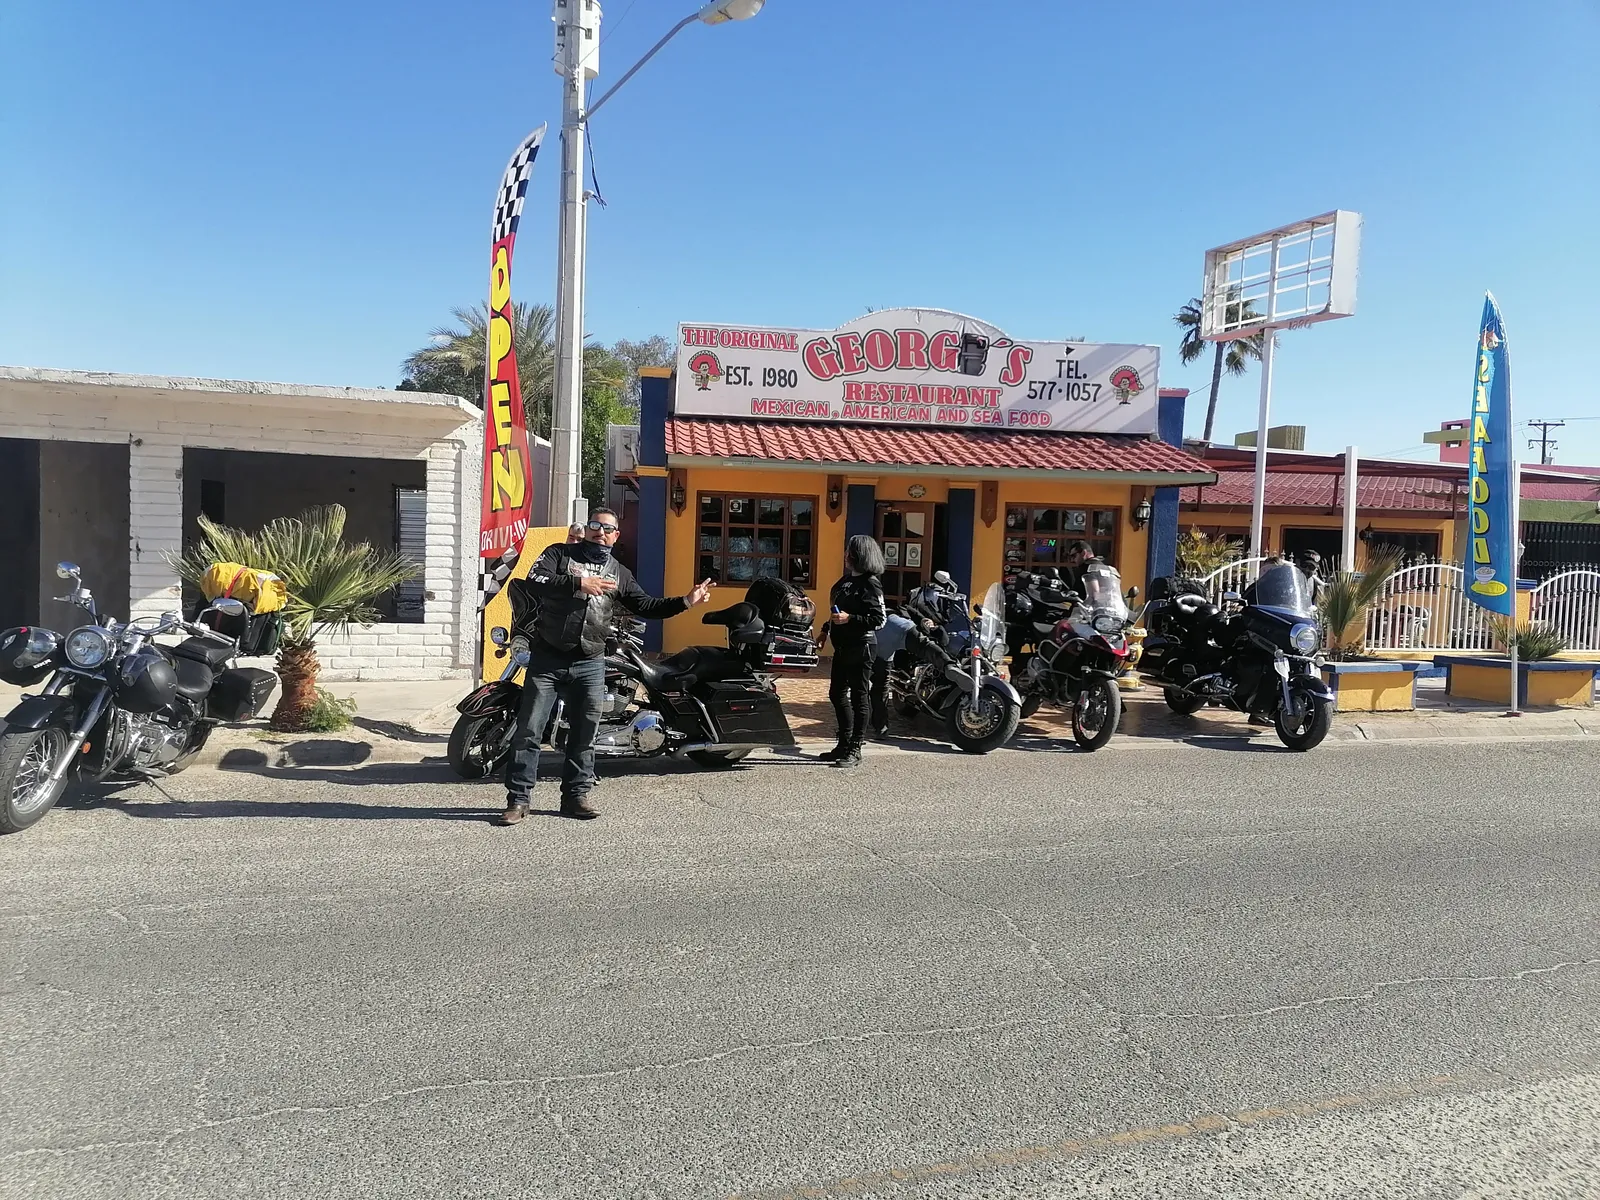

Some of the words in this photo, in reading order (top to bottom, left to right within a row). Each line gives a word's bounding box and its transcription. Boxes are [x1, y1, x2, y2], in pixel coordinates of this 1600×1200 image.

[682, 327, 718, 347] THE
[720, 330, 799, 351] ORIGINAL
[802, 328, 1034, 386] GEORG'S
[490, 246, 526, 511] OPEN
[725, 365, 753, 386] EST.
[762, 367, 798, 388] 1980
[1056, 359, 1088, 380] TEL.
[843, 382, 1004, 408] RESTAURANT
[841, 403, 931, 422] AMERICAN
[936, 407, 968, 424] AND
[971, 409, 1004, 426] SEA
[1008, 410, 1052, 427] FOOD
